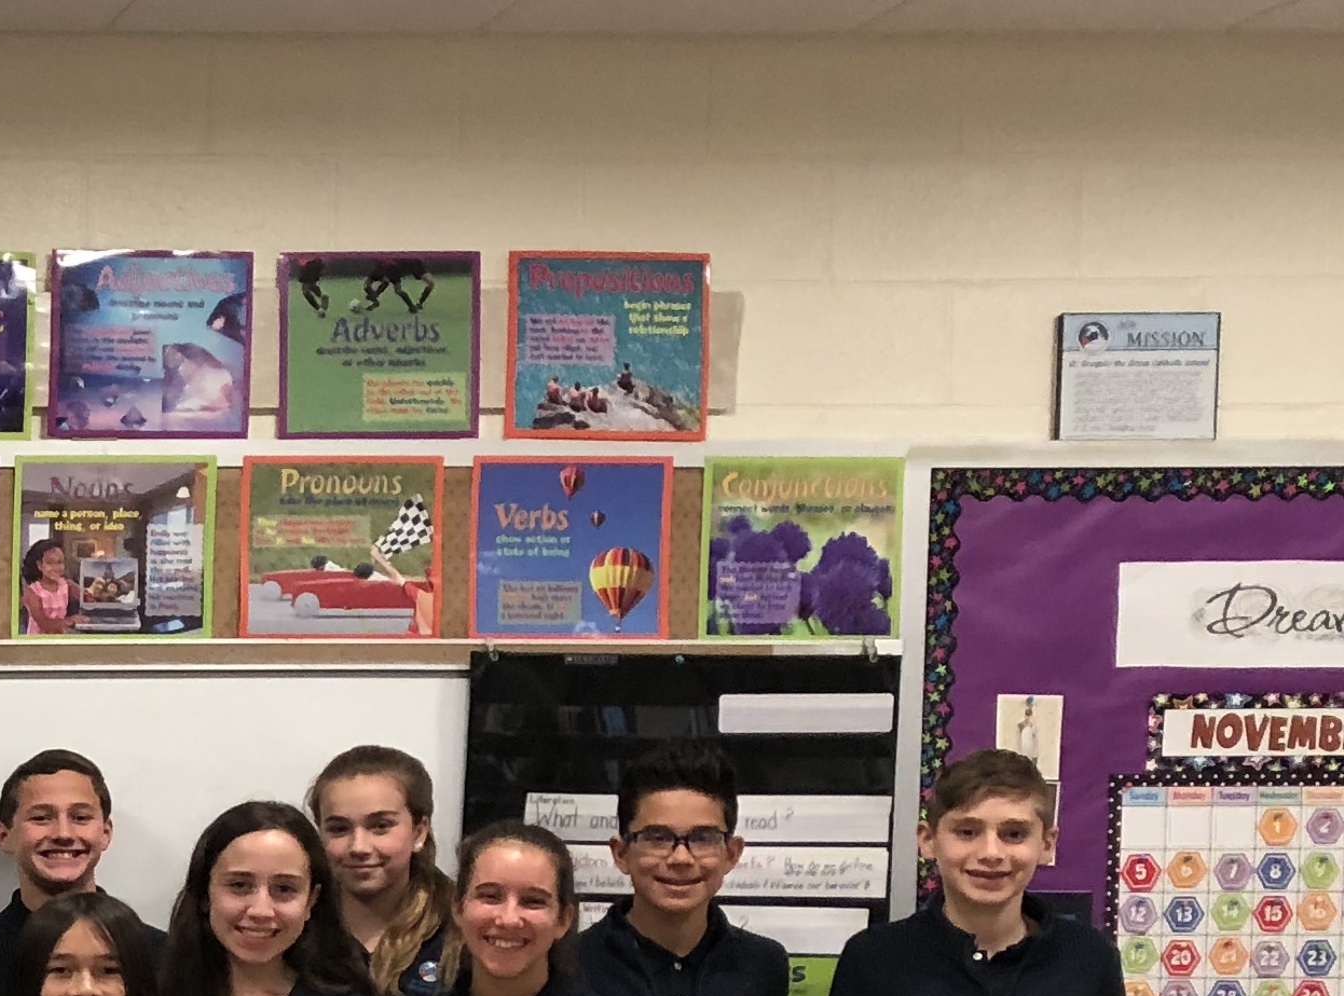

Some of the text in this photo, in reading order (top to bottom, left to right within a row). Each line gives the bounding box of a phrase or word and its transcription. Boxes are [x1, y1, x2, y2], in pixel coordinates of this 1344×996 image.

[528, 264, 695, 299] Prepositions
[330, 316, 440, 343] Adverbs
[1127, 330, 1206, 347] MISSION
[49, 475, 135, 499] Nouns
[280, 468, 403, 495] Pronouns
[722, 471, 888, 505] Conjunctions
[34, 510, 60, 519] name
[70, 509, 109, 521] person,
[494, 502, 570, 531] Verbs
[54, 521, 86, 533] thing,
[89, 523, 102, 531] or
[525, 534, 558, 544] action
[1191, 713, 1344, 752] NOVEMB
[1129, 790, 1159, 802] Sunday
[1219, 790, 1251, 802] Tuesday
[536, 801, 579, 828] What
[745, 810, 779, 831] read
[1273, 821, 1282, 834] 1
[1135, 863, 1147, 881] 5
[1228, 865, 1239, 879] 7
[1269, 864, 1282, 879] 8
[1129, 905, 1147, 921] 12
[1175, 904, 1193, 922] 13
[1264, 904, 1283, 922] 15
[1170, 948, 1192, 964] 20
[1261, 950, 1280, 965] 22
[1307, 949, 1327, 965] 23
